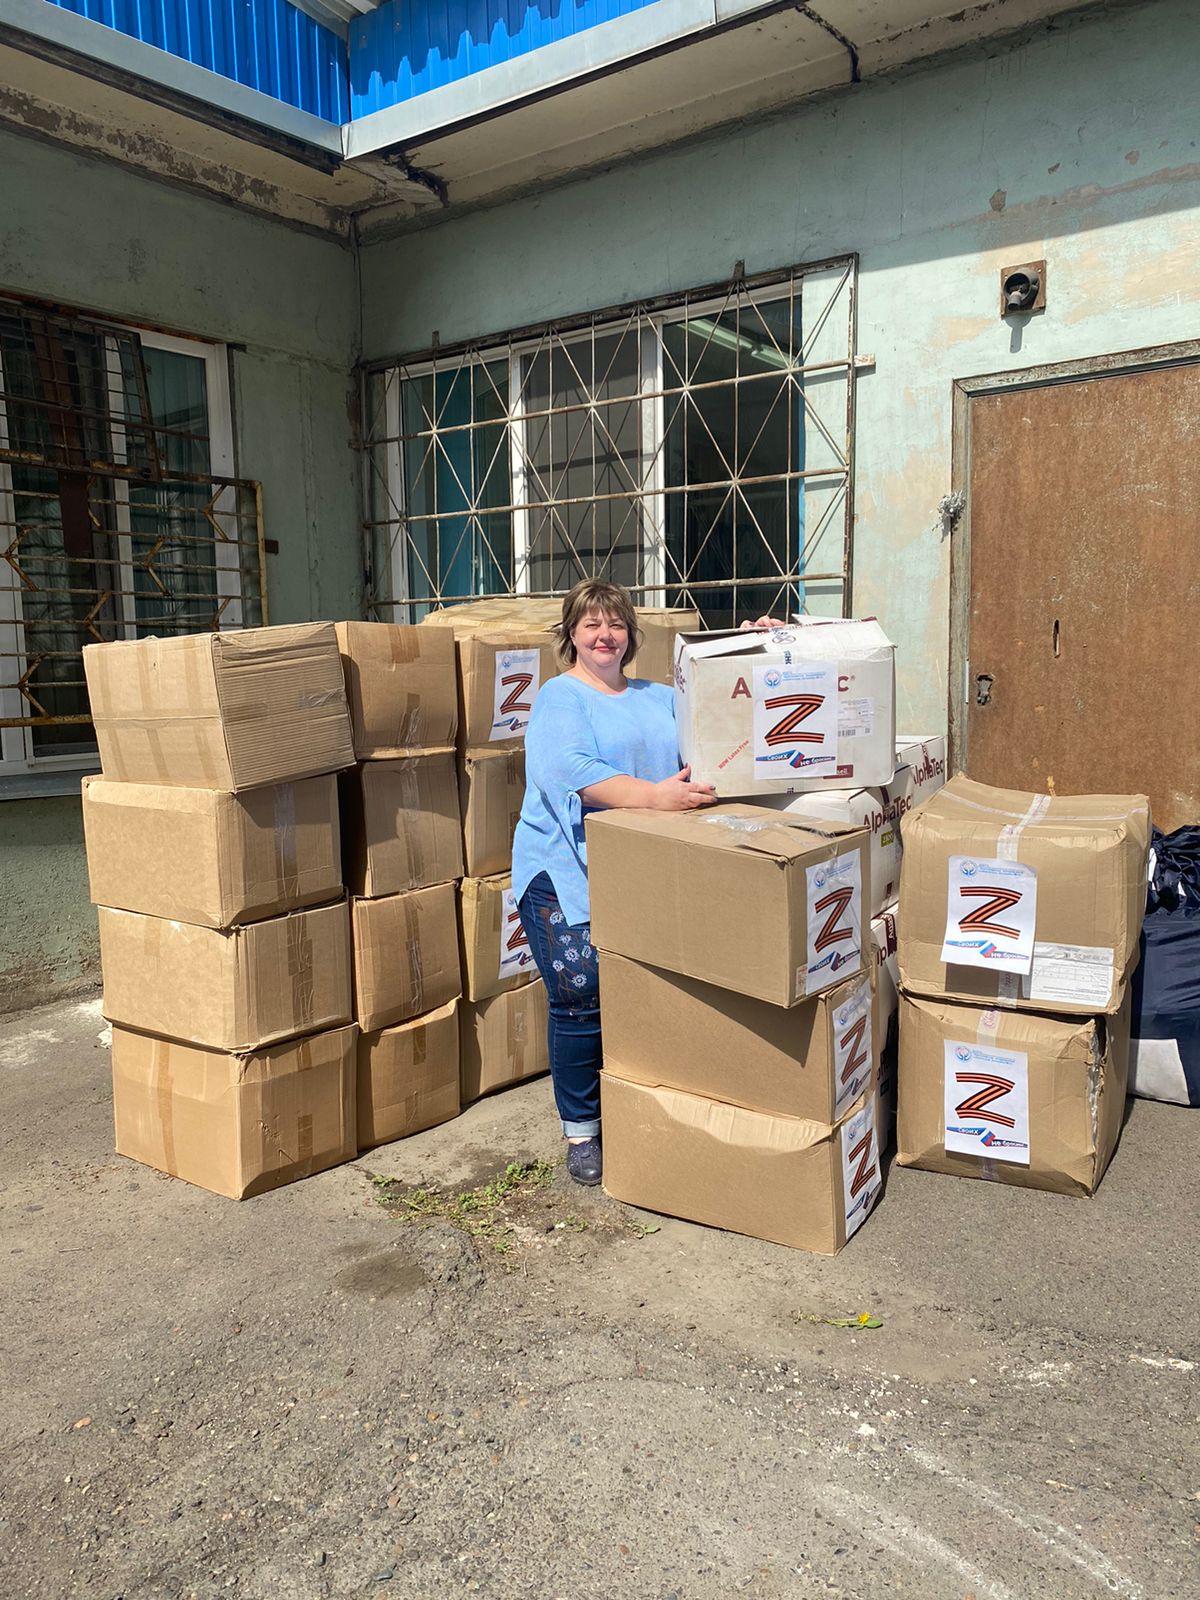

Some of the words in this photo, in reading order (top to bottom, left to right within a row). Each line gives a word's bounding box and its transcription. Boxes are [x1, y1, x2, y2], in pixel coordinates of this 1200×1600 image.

[500, 673, 534, 715] Z
[764, 694, 826, 746] Z
[814, 886, 854, 954] Z
[958, 886, 1023, 940] Z
[840, 1014, 867, 1086] Z
[955, 1072, 1015, 1128] Z
[848, 1127, 876, 1199] Z
